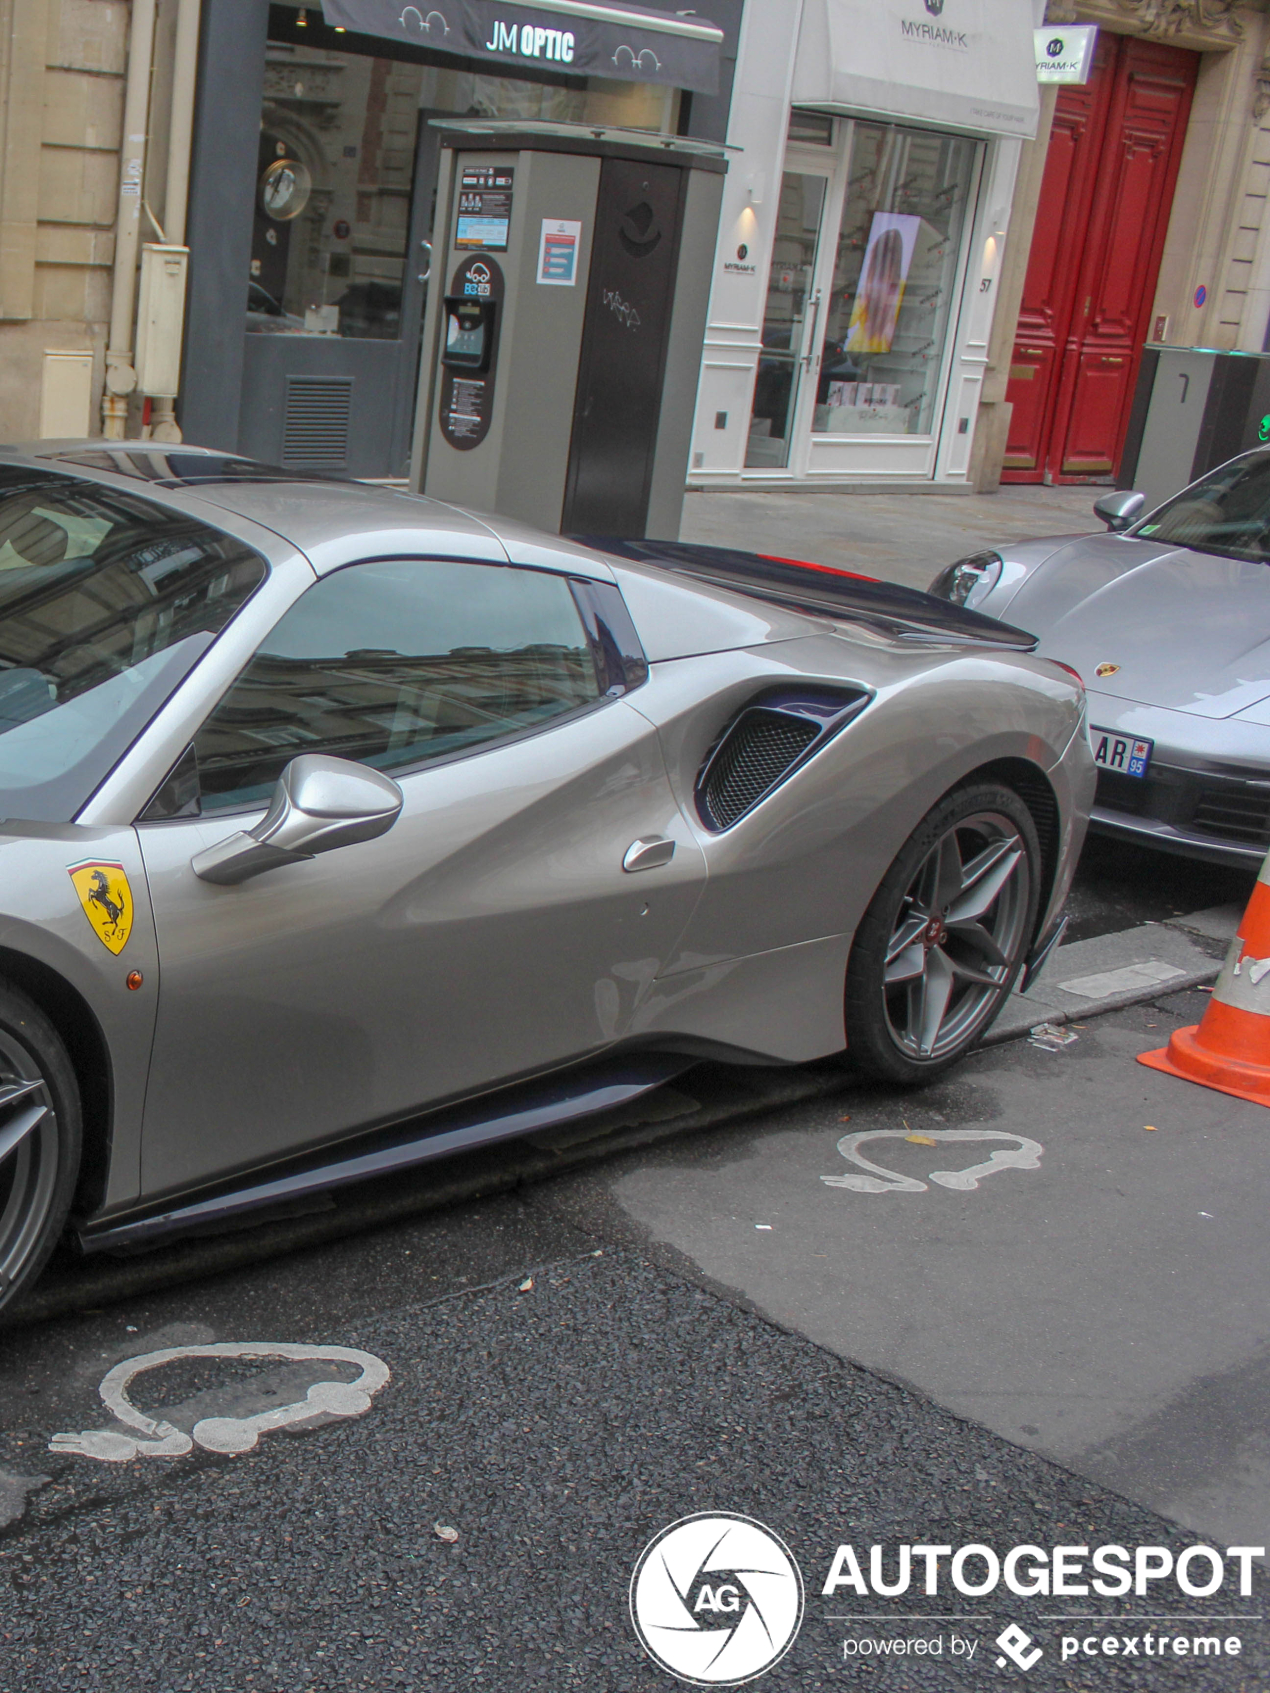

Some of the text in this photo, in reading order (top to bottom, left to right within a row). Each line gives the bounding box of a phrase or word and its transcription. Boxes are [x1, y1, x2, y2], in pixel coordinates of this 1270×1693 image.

[486, 20, 575, 63] JM OPTIC
[980, 278, 991, 292] 57
[1095, 736, 1126, 768] AR
[1130, 759, 1143, 773] 95
